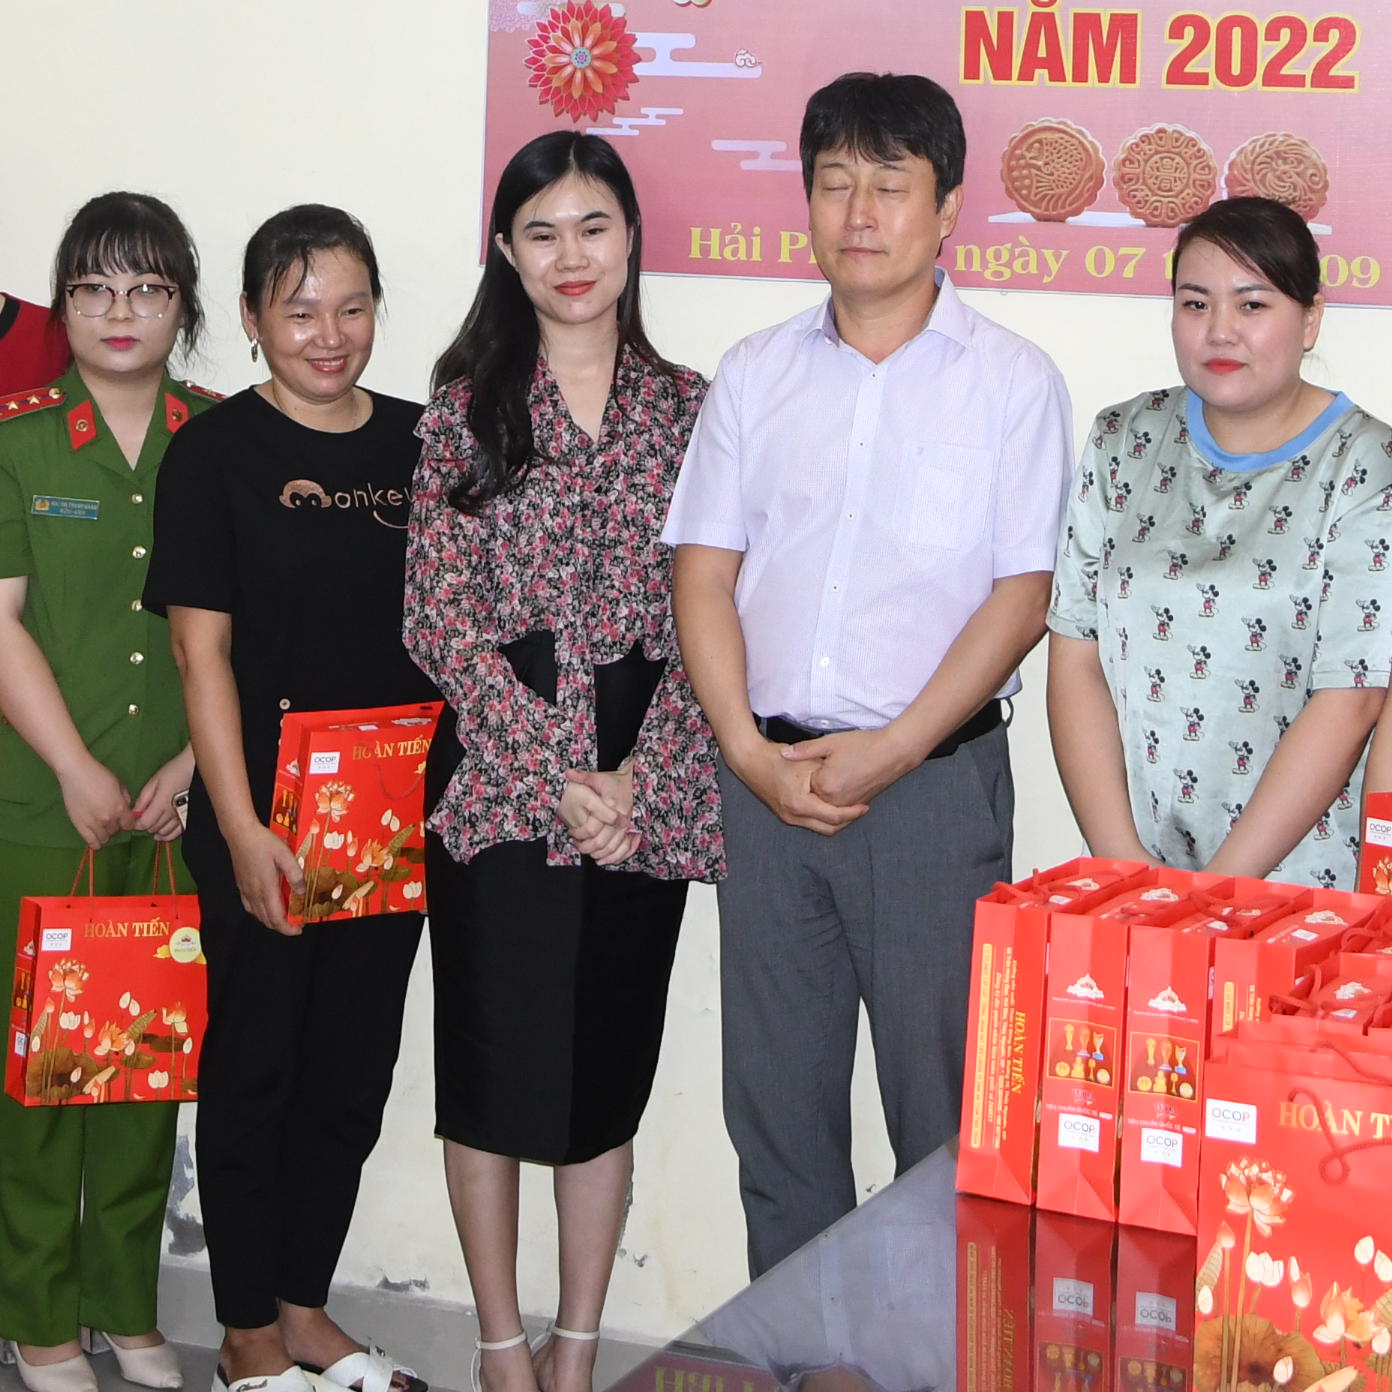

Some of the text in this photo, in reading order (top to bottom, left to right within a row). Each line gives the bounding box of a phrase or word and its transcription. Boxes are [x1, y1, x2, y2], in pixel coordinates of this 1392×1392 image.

[1164, 13, 1358, 91] 2022
[689, 223, 763, 263] Hải
[954, 235, 1069, 284] ngày
[1085, 246, 1146, 279] 07
[1319, 254, 1380, 290] 09
[1212, 1107, 1250, 1122] OCOP
[1064, 1120, 1095, 1134] OCOP
[1146, 1134, 1178, 1149] OCOP
